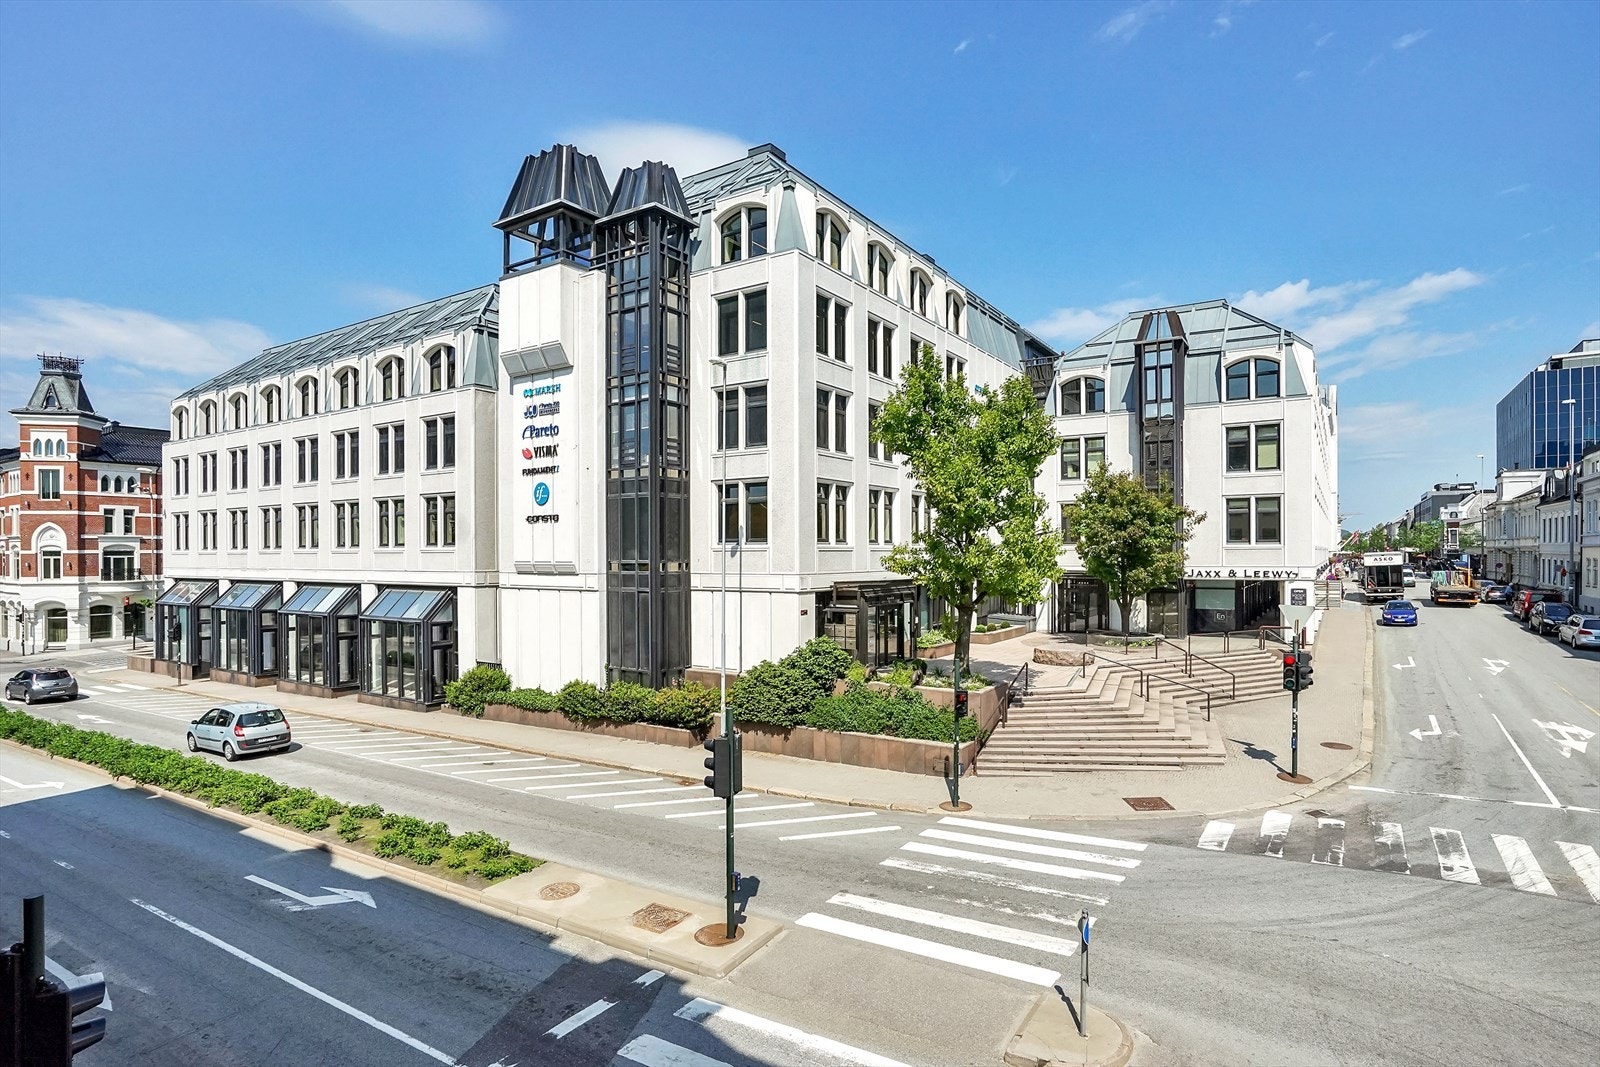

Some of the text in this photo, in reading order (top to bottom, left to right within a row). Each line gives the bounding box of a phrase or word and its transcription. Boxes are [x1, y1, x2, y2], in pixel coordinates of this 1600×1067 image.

[523, 424, 559, 440] Pareto
[533, 446, 559, 459] VISMA
[1187, 569, 1294, 578] JAXX & LEEWY
